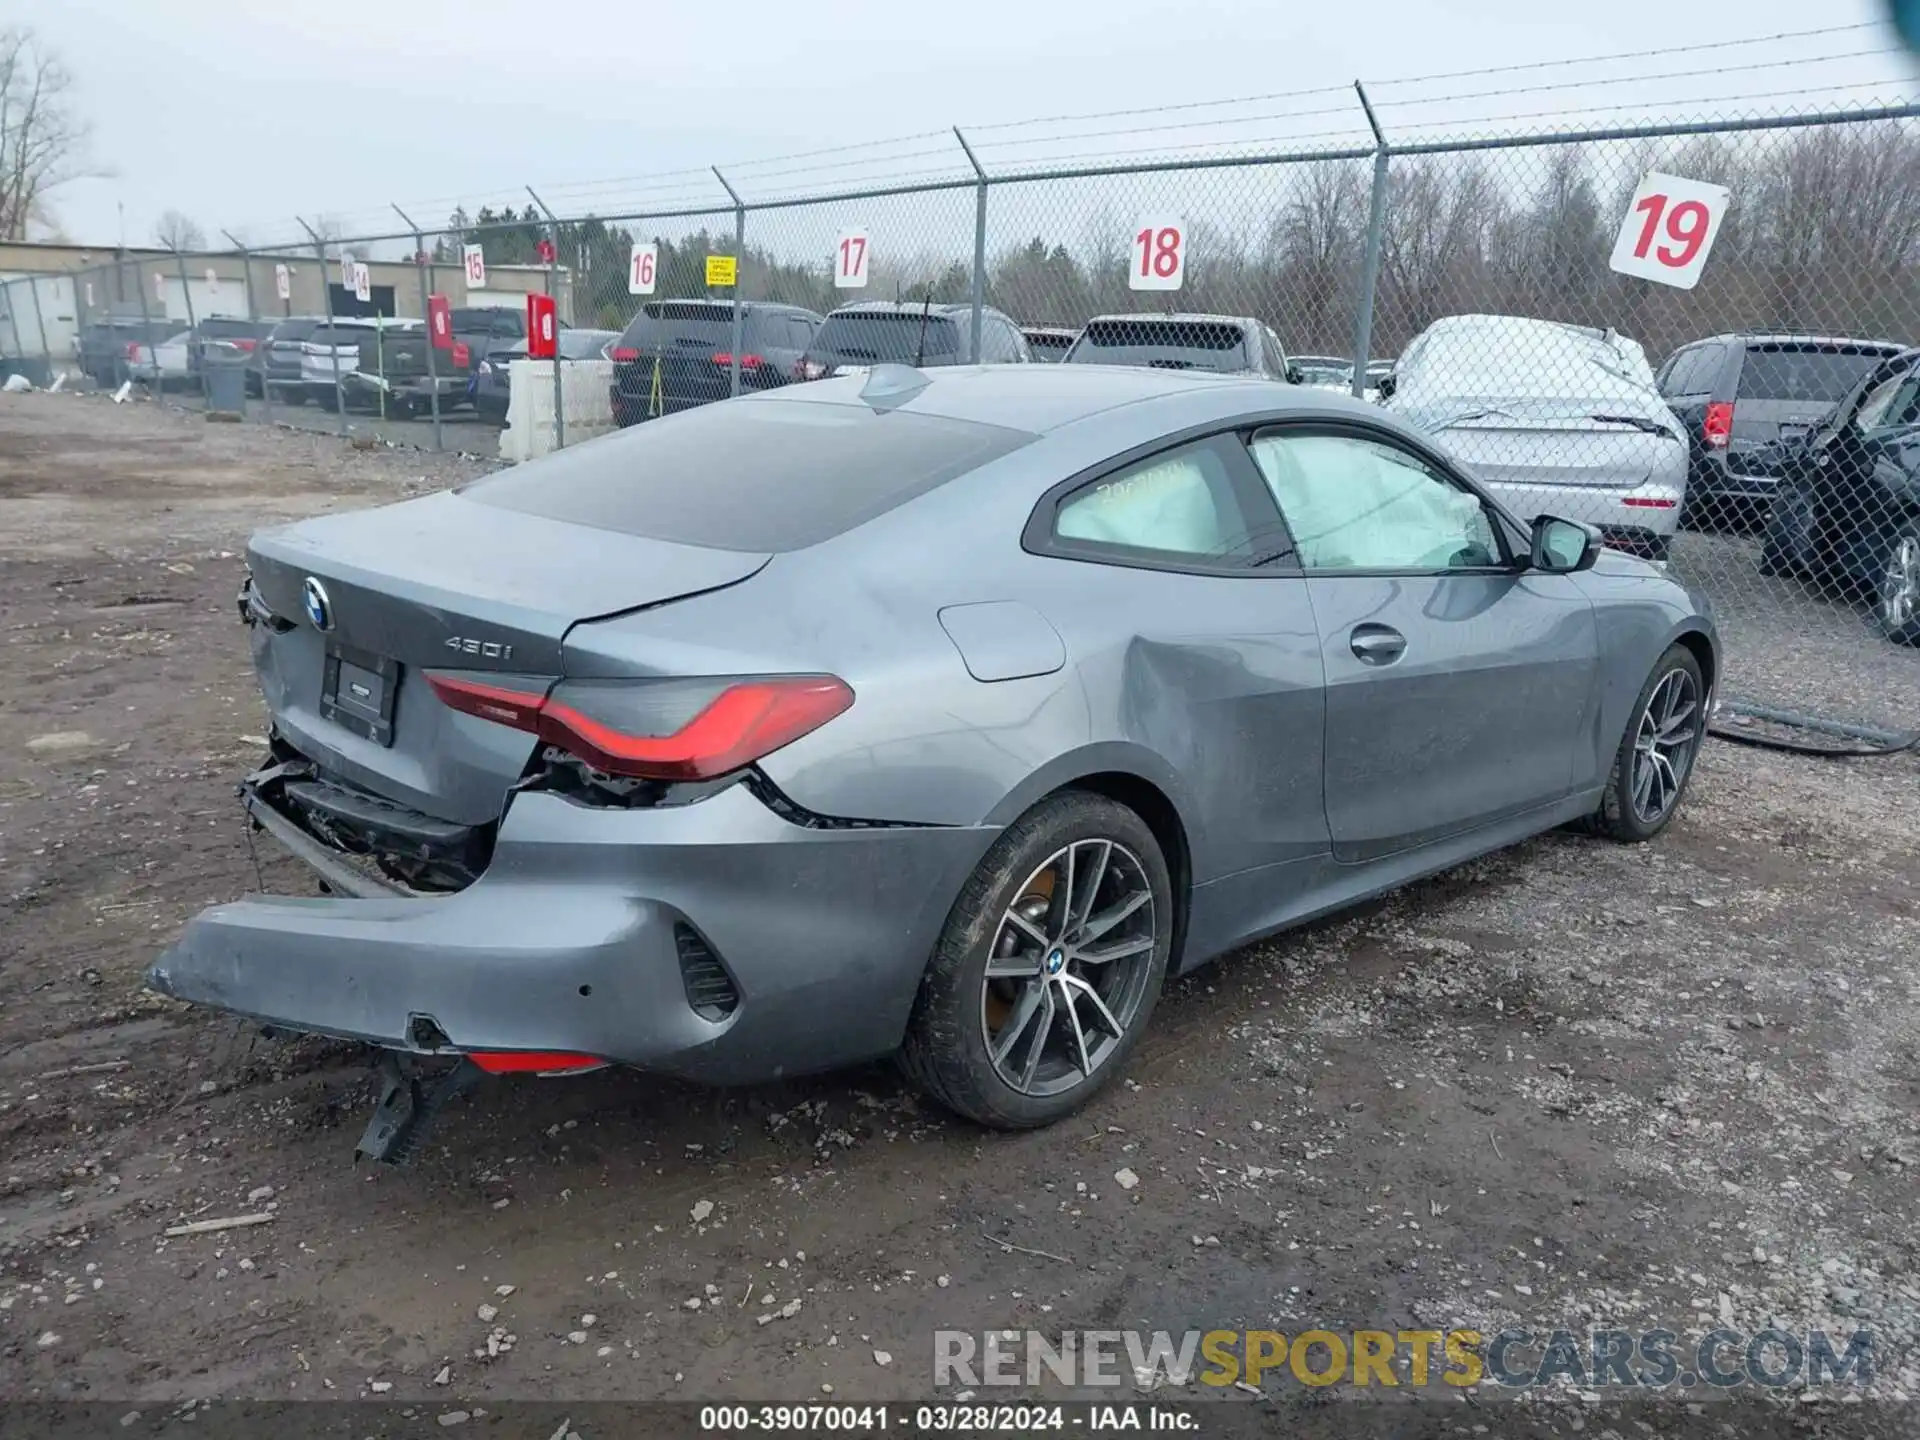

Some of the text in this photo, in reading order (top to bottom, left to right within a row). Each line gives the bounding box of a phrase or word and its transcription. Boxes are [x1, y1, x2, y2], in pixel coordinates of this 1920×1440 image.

[1633, 193, 1710, 268] 19
[466, 252, 483, 281] 15
[633, 253, 654, 285] 16
[840, 237, 866, 277] 17
[1136, 227, 1181, 278] 18
[445, 636, 513, 660] 430i
